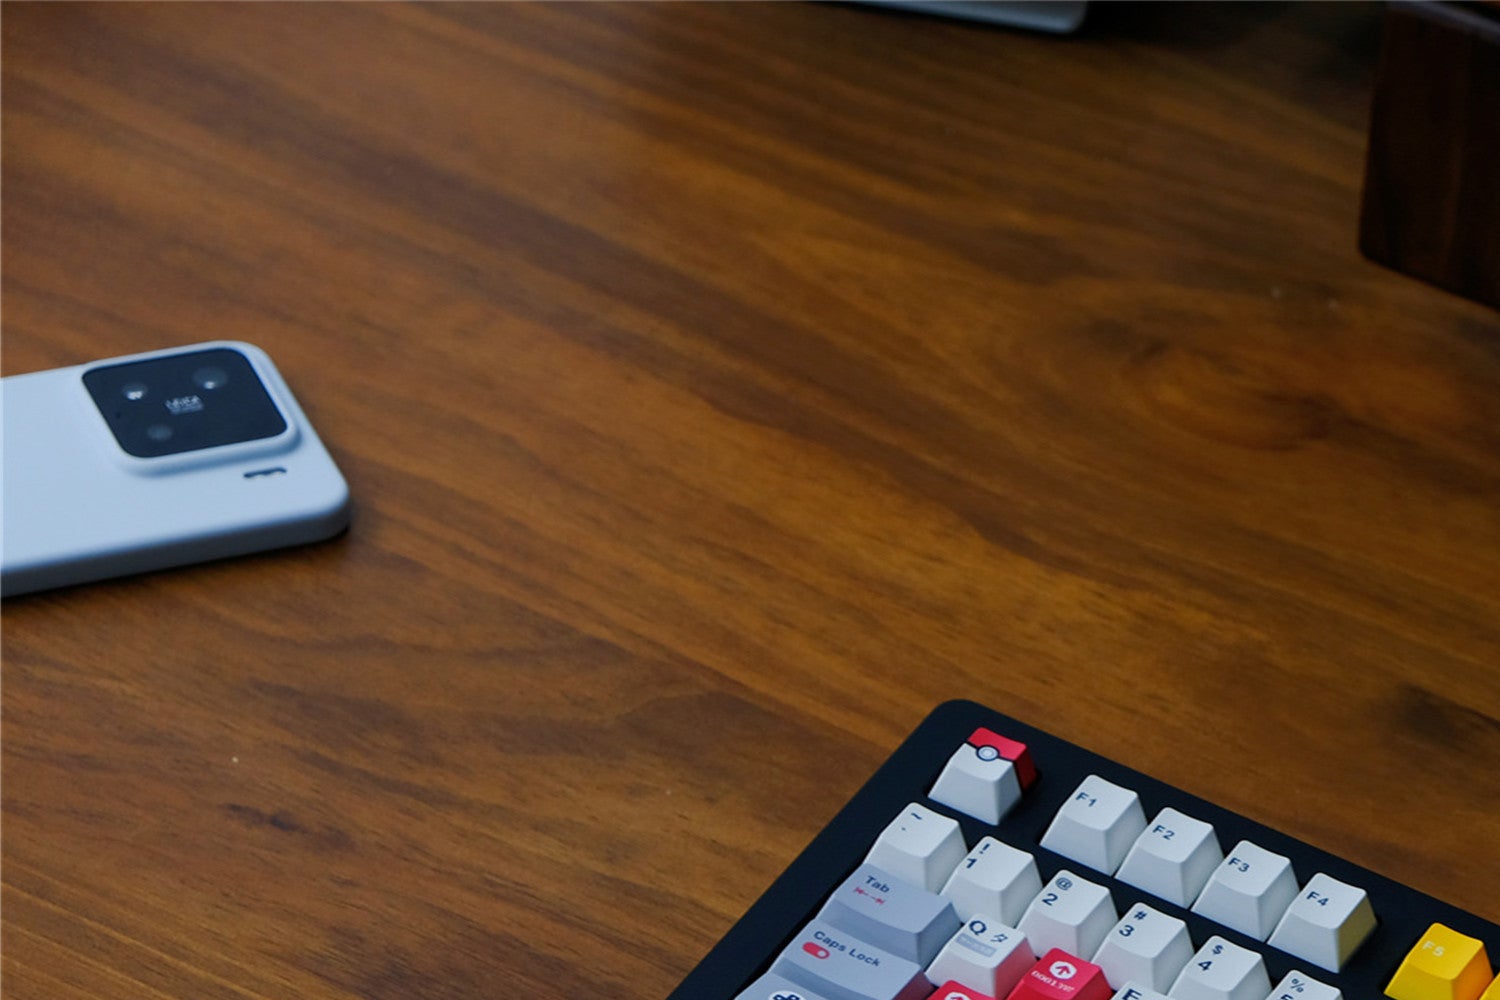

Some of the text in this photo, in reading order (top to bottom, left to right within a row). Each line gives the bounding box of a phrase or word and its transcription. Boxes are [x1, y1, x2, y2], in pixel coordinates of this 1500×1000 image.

[1075, 791, 1098, 808] F1
[1152, 824, 1176, 841] F2
[966, 858, 977, 869] 1
[1227, 856, 1251, 873] F3
[866, 876, 891, 893] Tab
[1055, 877, 1073, 891] @
[1041, 892, 1058, 905] 2
[1306, 890, 1330, 907] F4
[1134, 910, 1147, 920] #
[969, 920, 987, 935] Q
[1119, 924, 1135, 937] 3
[813, 930, 881, 967] Caps Lock
[1212, 944, 1224, 955] $
[1421, 939, 1446, 957] F5
[1197, 960, 1213, 972] 4
[1290, 977, 1304, 993] %
